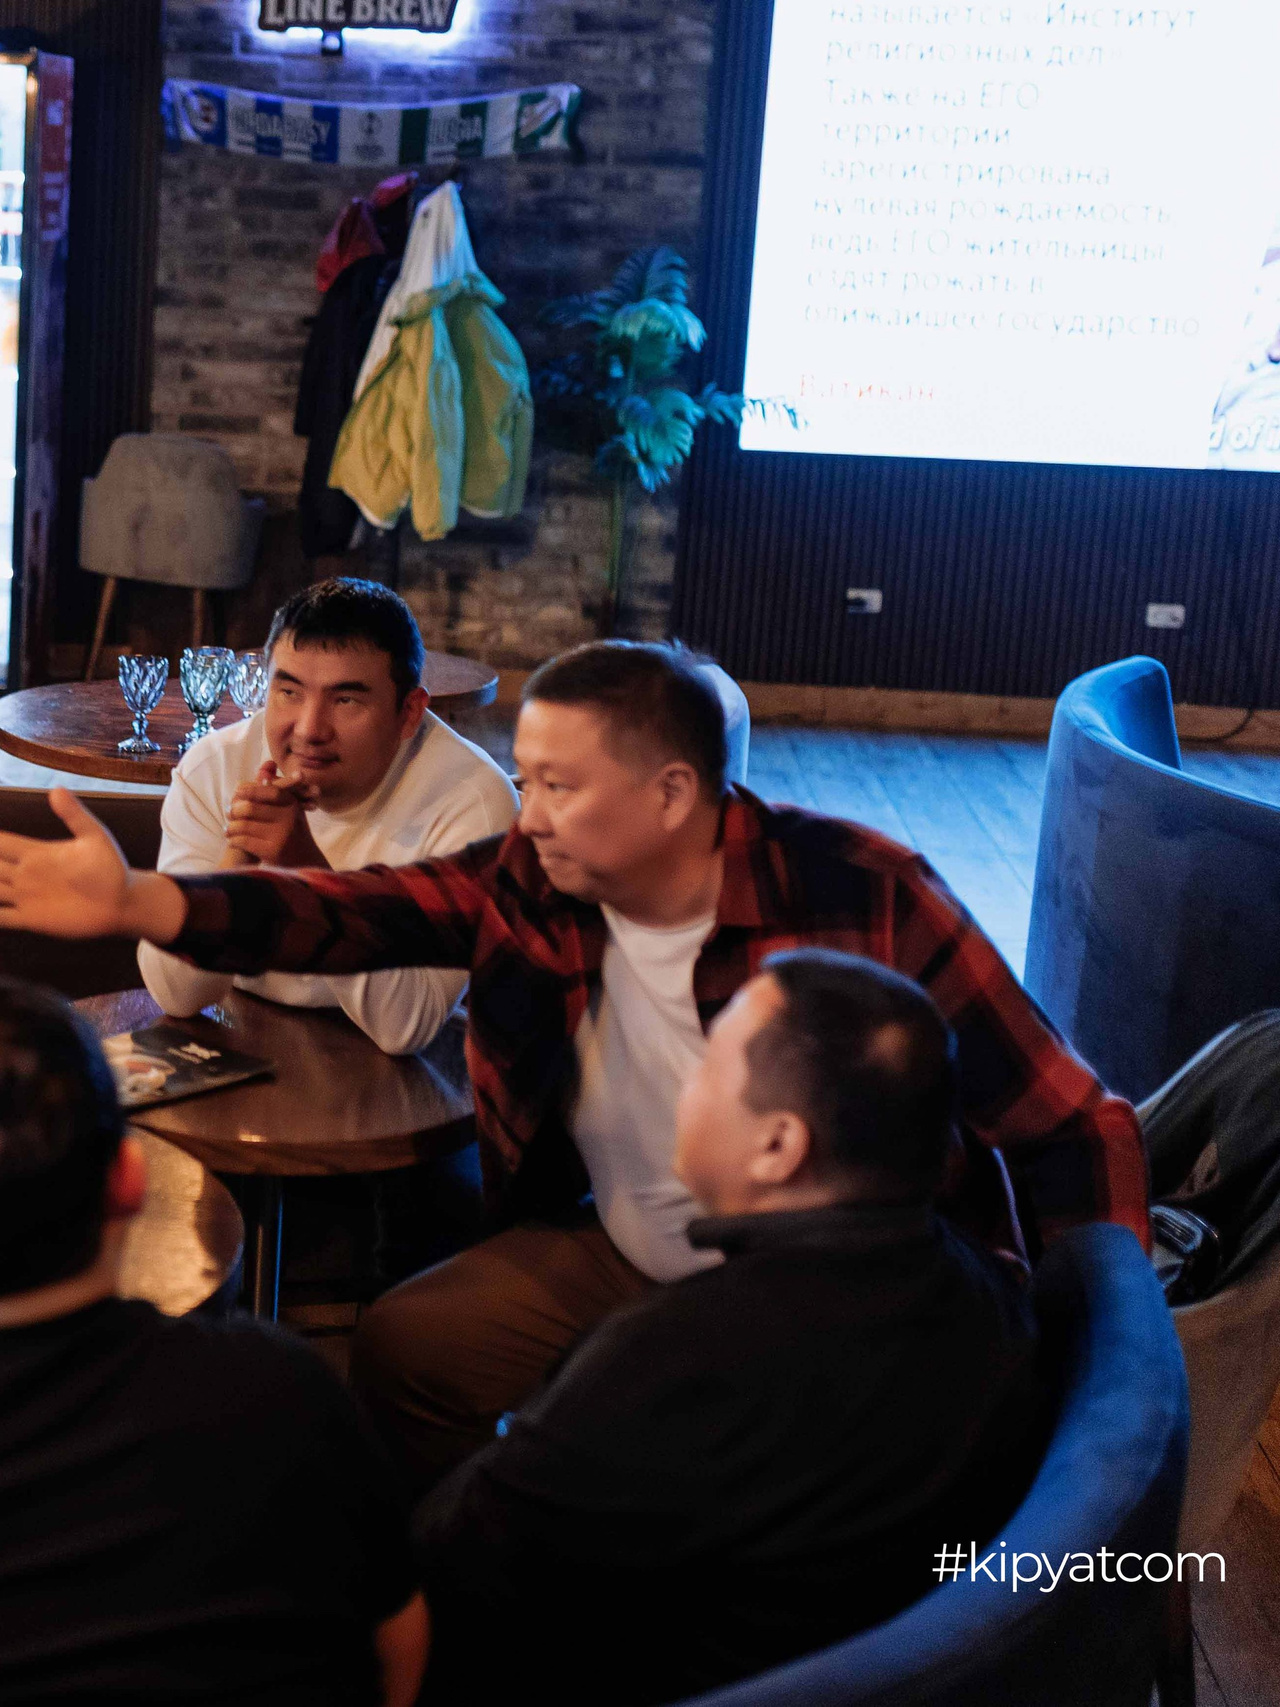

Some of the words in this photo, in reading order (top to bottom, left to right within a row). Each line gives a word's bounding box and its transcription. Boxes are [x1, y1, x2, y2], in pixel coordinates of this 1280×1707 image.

[265, 0, 346, 26] LINE
[351, 0, 453, 27] BREW
[824, 79, 920, 106] Также
[932, 89, 967, 107] на
[980, 81, 1040, 110] ЕГО
[822, 123, 1011, 150] территории
[810, 231, 880, 255] ведь
[892, 228, 952, 256] ЕГО
[966, 238, 1166, 263] жительницы
[903, 271, 1020, 294] рожать
